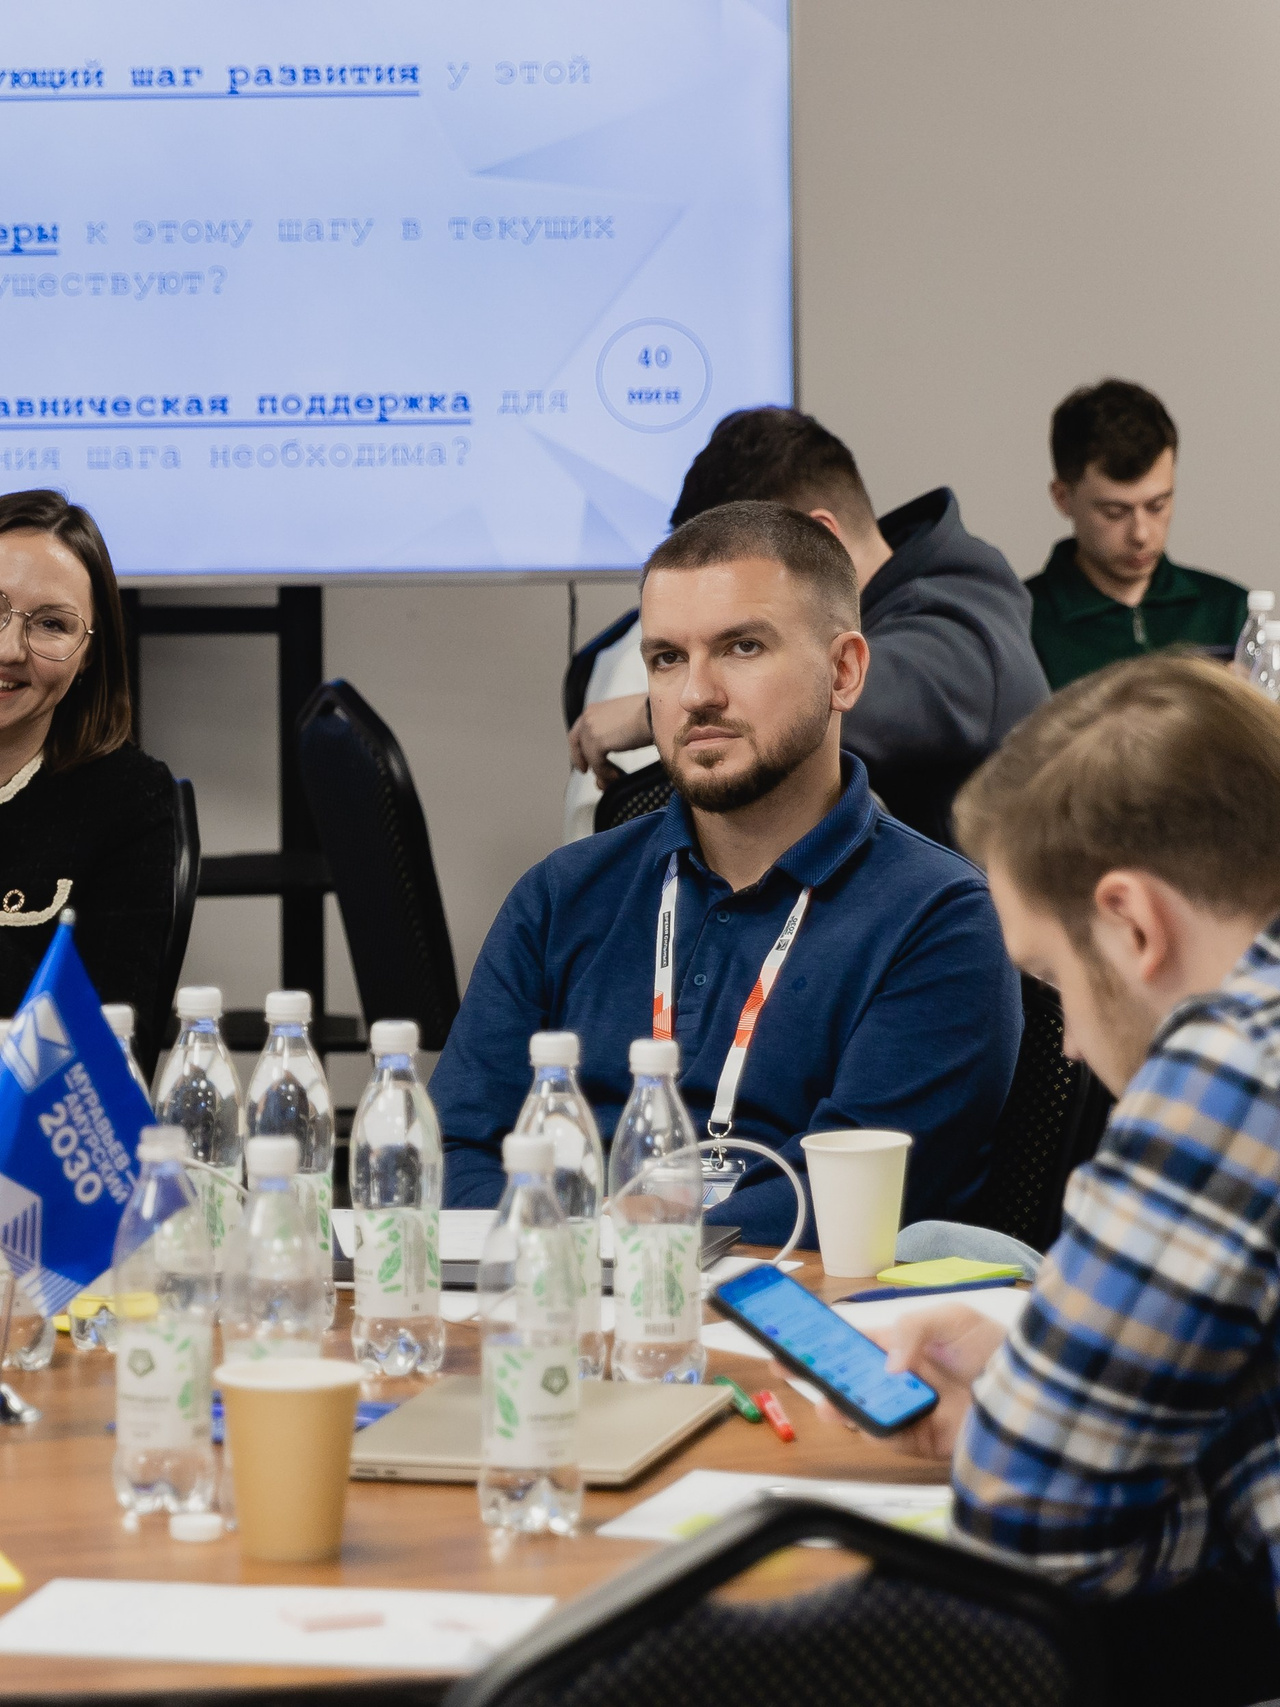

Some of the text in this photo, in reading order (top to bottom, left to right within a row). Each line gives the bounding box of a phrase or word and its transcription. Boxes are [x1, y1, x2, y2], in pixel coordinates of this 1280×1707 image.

[130, 64, 203, 89] шаг
[227, 62, 420, 95] развития
[445, 60, 472, 92] у
[494, 54, 591, 86] этой
[133, 218, 254, 248] этому
[277, 216, 376, 247] шагу
[448, 214, 616, 246] текущих
[637, 344, 672, 369] 40
[257, 389, 471, 422] поддержка
[497, 389, 569, 416] для
[86, 443, 183, 471] шага
[208, 434, 472, 469] необходима?
[38, 1101, 104, 1205] 2030
